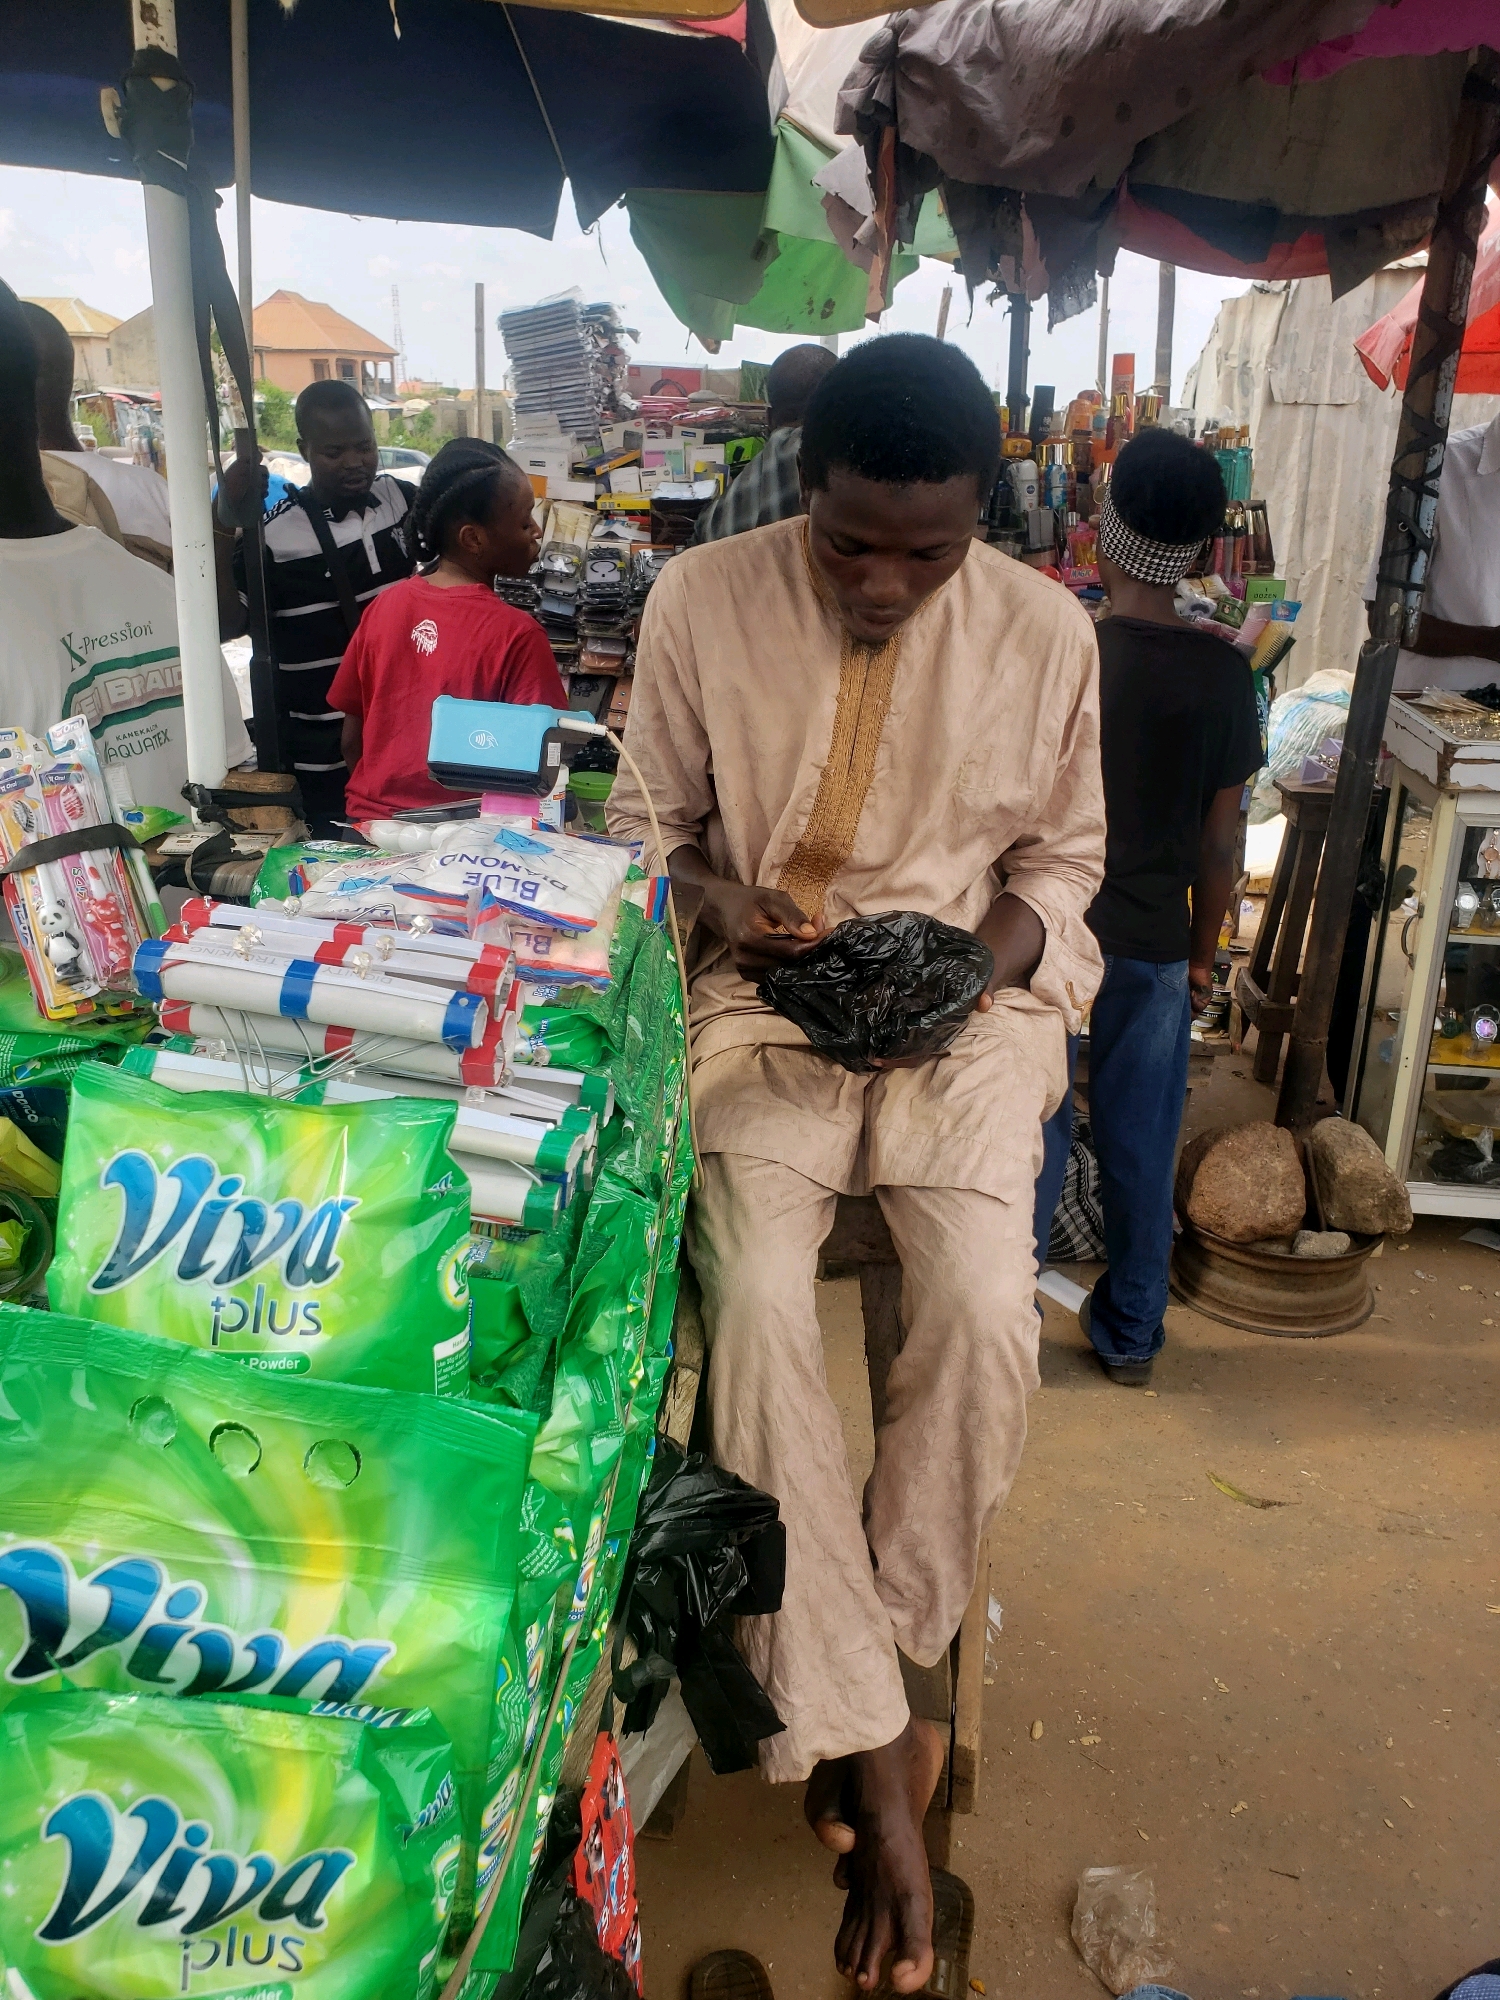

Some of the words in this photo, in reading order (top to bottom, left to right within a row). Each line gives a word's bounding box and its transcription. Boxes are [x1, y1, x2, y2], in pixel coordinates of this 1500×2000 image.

[106, 728, 171, 763] AQUATEX
[439, 852, 569, 892] DIAMOND
[462, 871, 541, 902] BLUE
[90, 1149, 360, 1294] Viva
[210, 1283, 323, 1347] plus
[248, 1356, 301, 1370] Powder
[0, 1542, 394, 1701] Viva
[36, 1792, 355, 1946] Viva
[179, 1926, 305, 1991] plus
